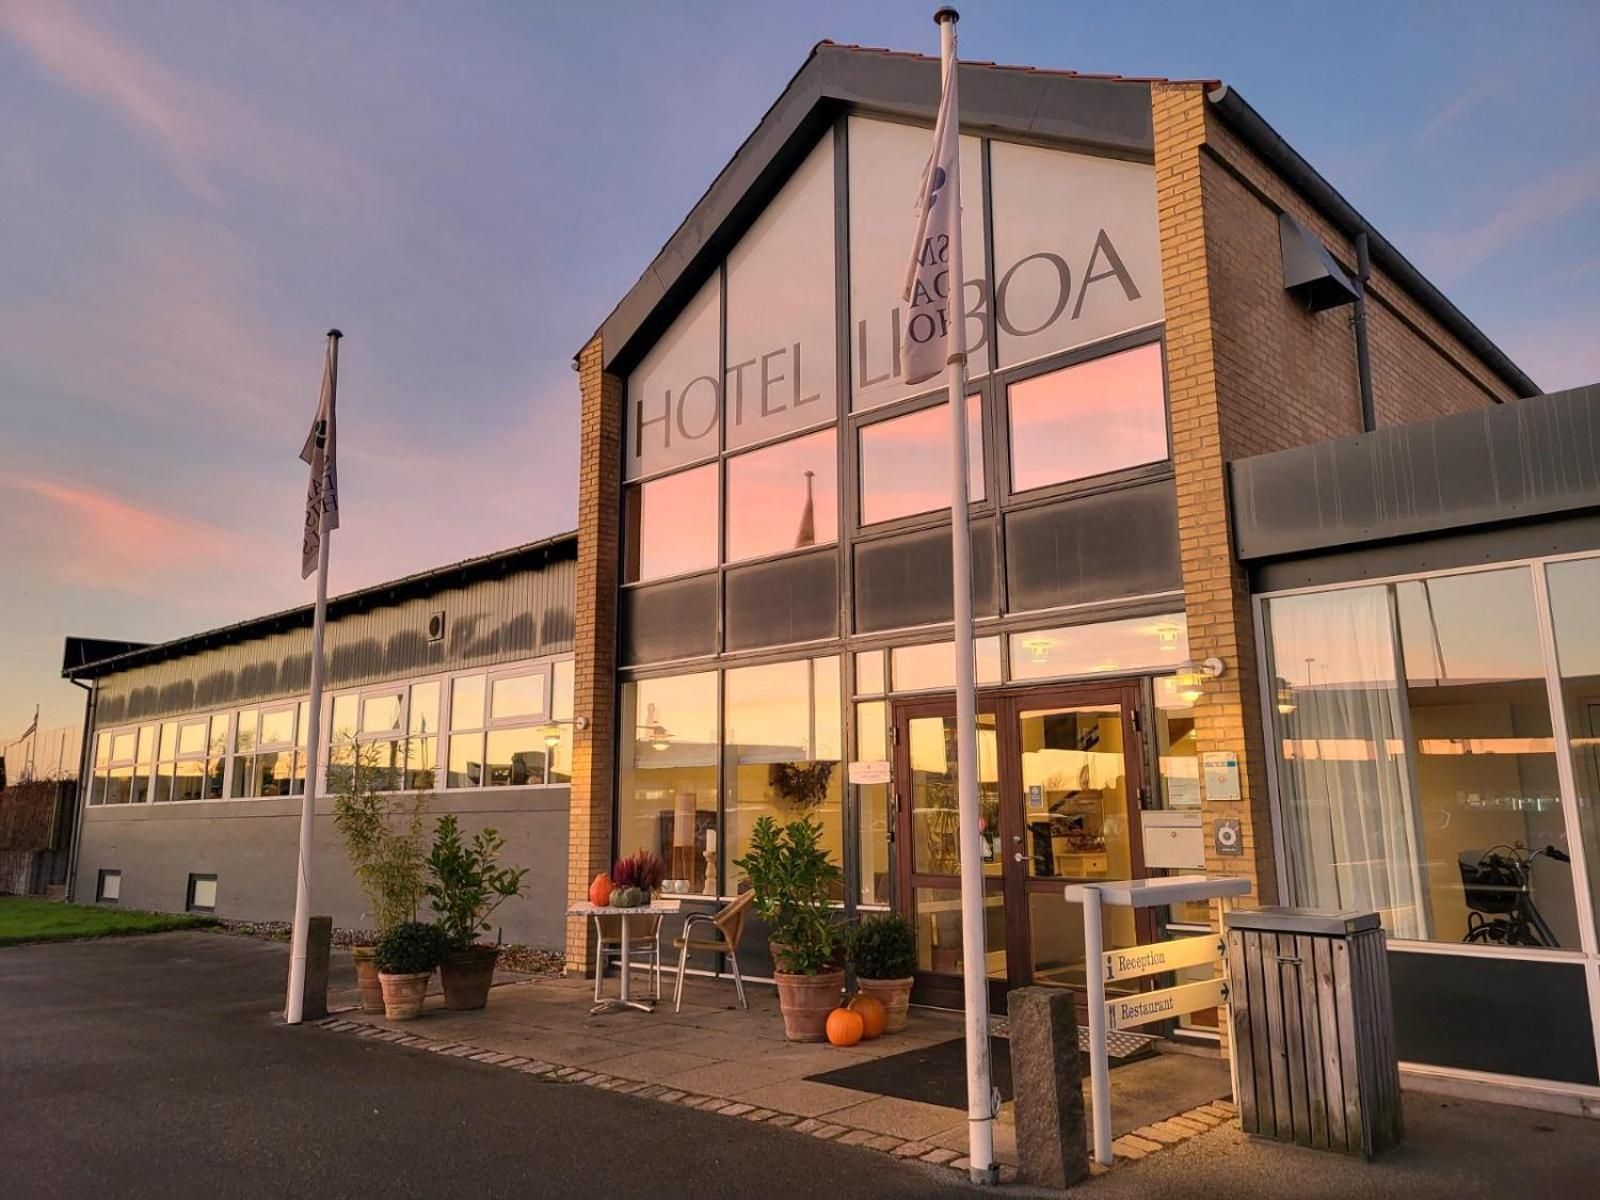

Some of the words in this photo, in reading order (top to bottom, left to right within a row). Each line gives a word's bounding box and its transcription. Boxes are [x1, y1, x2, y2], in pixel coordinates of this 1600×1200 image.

[635, 341, 821, 458] HOTEL
[857, 227, 1142, 389] LIBOA
[1118, 951, 1166, 972] Reception
[1121, 997, 1174, 1020] Restaurant
